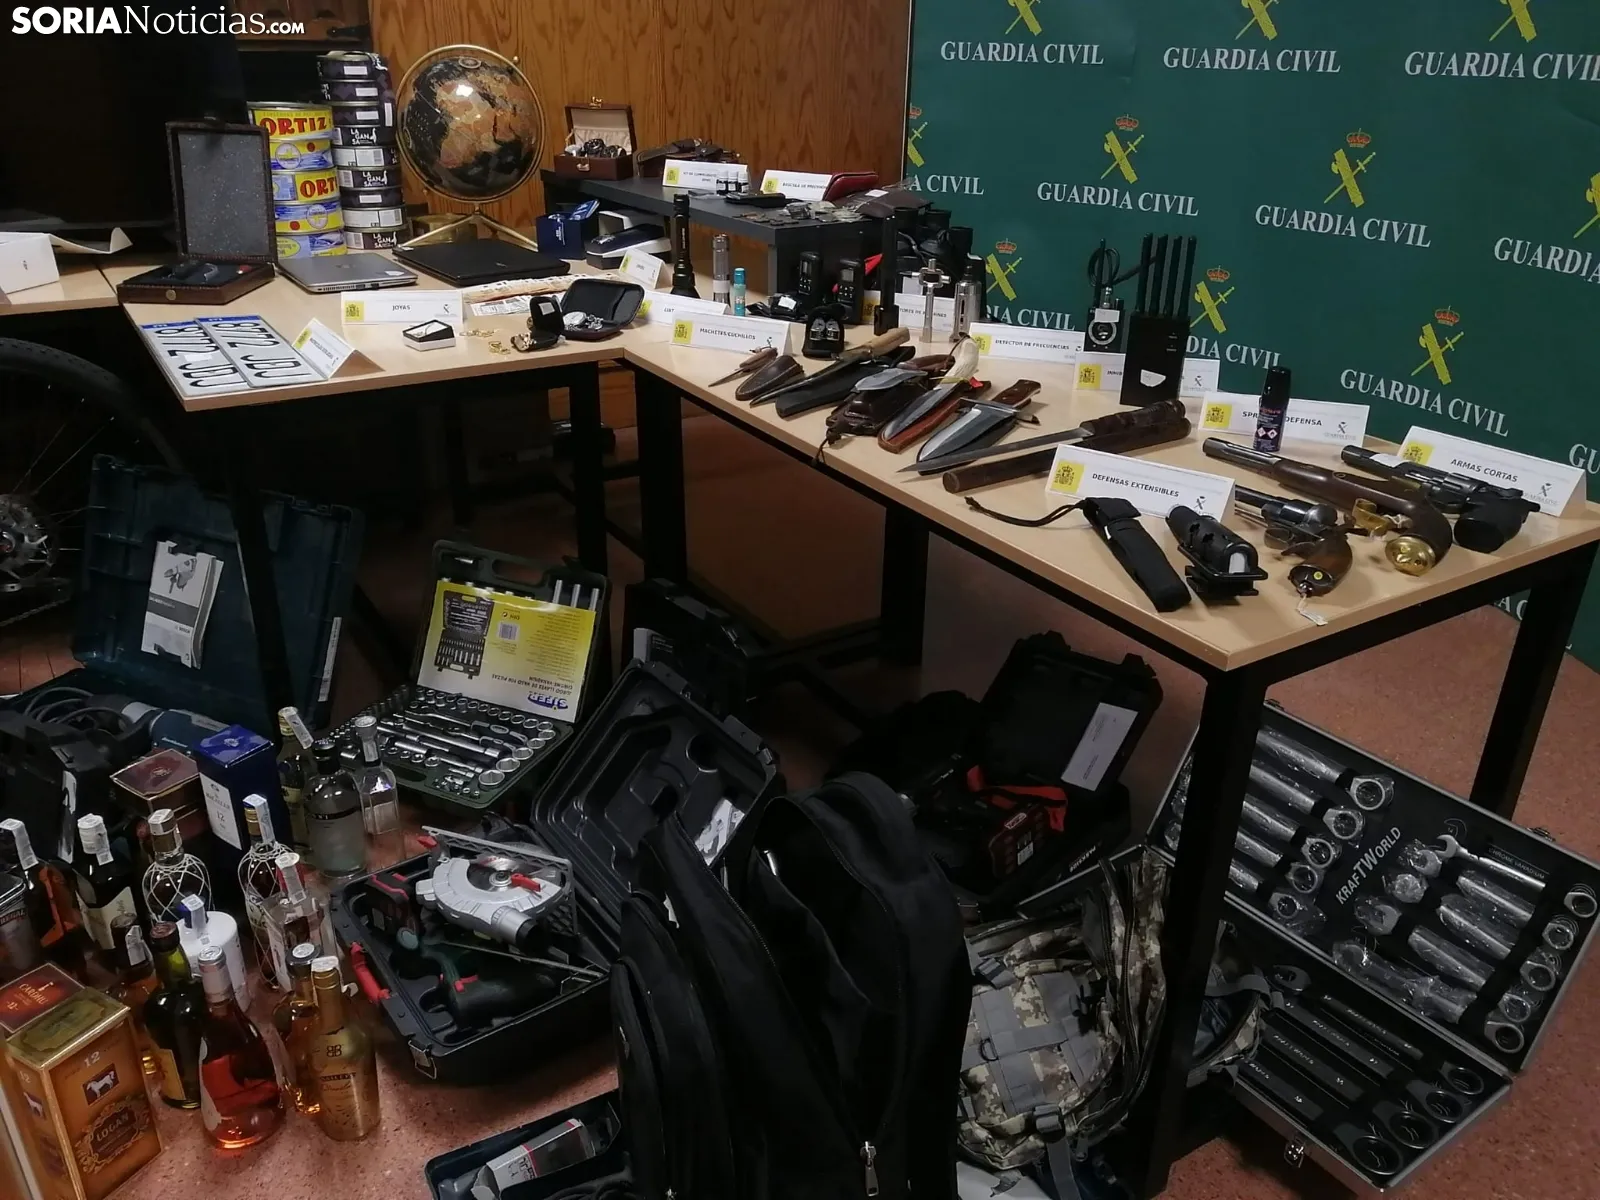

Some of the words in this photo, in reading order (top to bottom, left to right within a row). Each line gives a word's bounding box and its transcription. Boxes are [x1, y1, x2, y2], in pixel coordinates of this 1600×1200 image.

[940, 41, 1039, 63] GUARDIA
[1043, 43, 1105, 65] CIVIL
[1163, 47, 1270, 71] GUARDIA
[1276, 49, 1341, 73] CIVIL
[1404, 51, 1526, 78] GUARDIA
[1532, 53, 1600, 81] CIVIL
[260, 117, 327, 136] ORTIZ
[300, 178, 338, 198] ORTI
[926, 174, 985, 195] CIVIL
[1036, 182, 1133, 210] GUARDIA
[1137, 192, 1199, 217] CIVIL
[1255, 204, 1357, 237] GUARDIA
[1362, 218, 1432, 248] CIVIL
[1017, 308, 1076, 331] CIVIL
[240, 353, 312, 379] JBJ
[1340, 369, 1442, 415] GUARDIA
[1448, 398, 1509, 437] CIVIL
[1242, 411, 1258, 419] SPR
[1285, 416, 1323, 426] DEFENSA
[1450, 458, 1482, 473] ARMAS
[1483, 467, 1519, 483] CORTAS
[1092, 473, 1130, 487] DEFENSAS
[1130, 481, 1180, 497] EXTENSIBLES
[1335, 826, 1402, 905] KRAFTWORLD
[84, 1050, 100, 1069] 12
[96, 1112, 130, 1142] LOGAN
